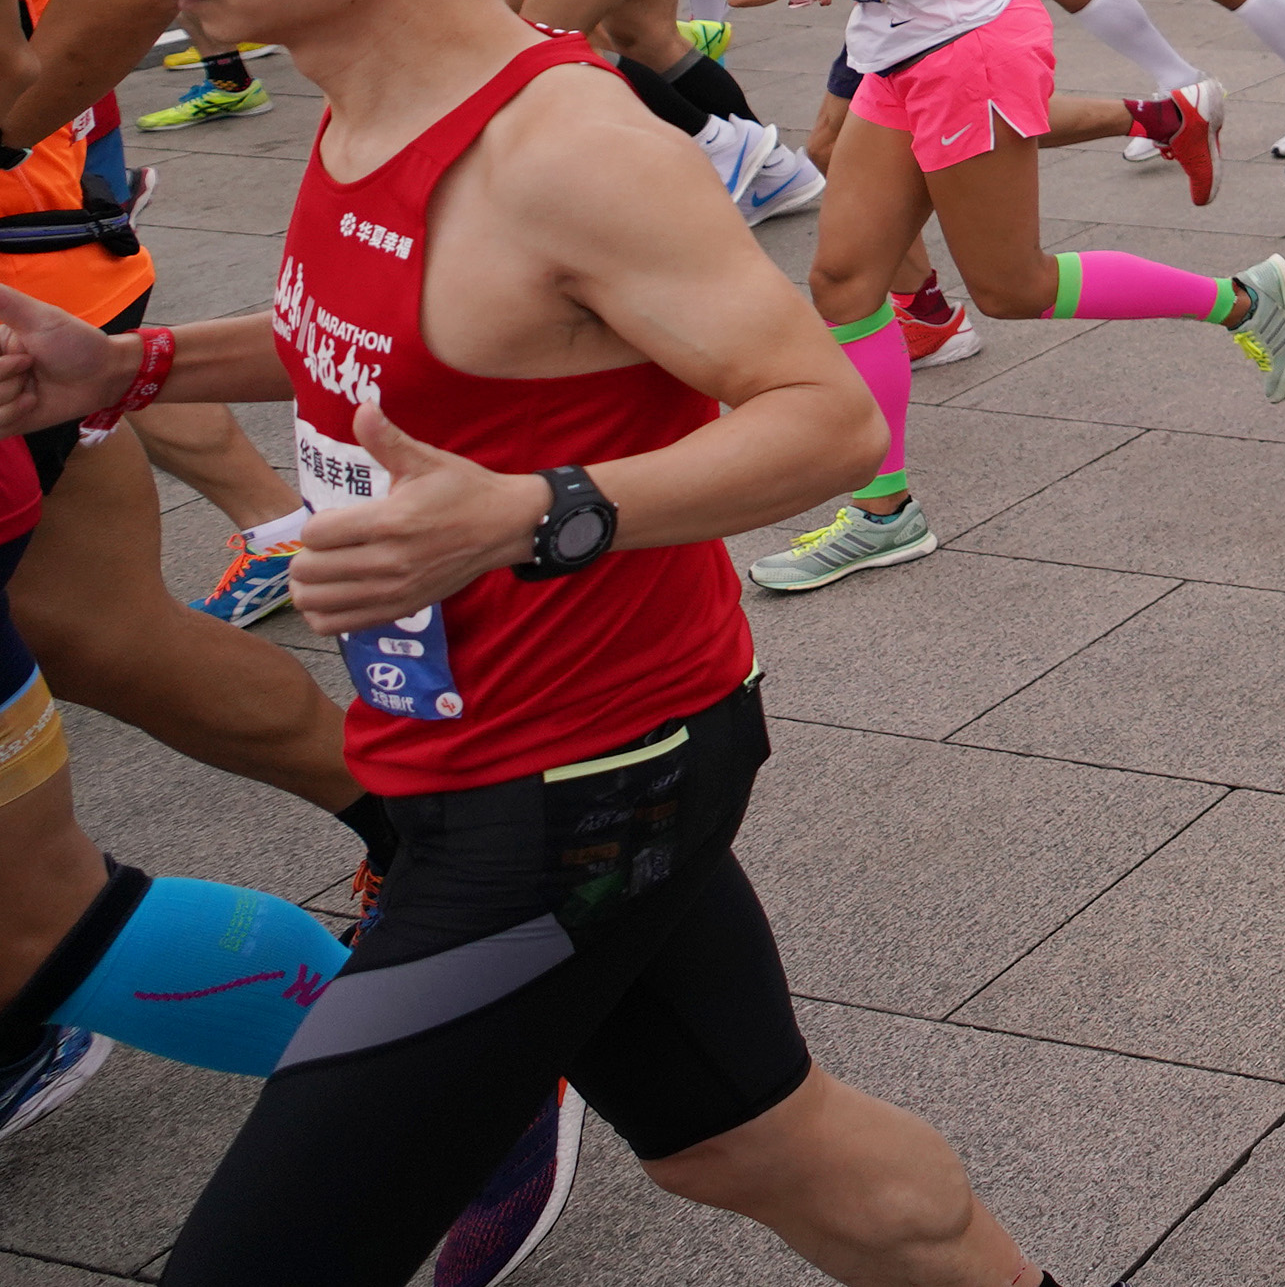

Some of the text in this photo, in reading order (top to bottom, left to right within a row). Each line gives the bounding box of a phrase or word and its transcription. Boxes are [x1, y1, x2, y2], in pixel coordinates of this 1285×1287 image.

[356, 219, 414, 261] 华夏幸福
[316, 306, 393, 355] MARATHON
